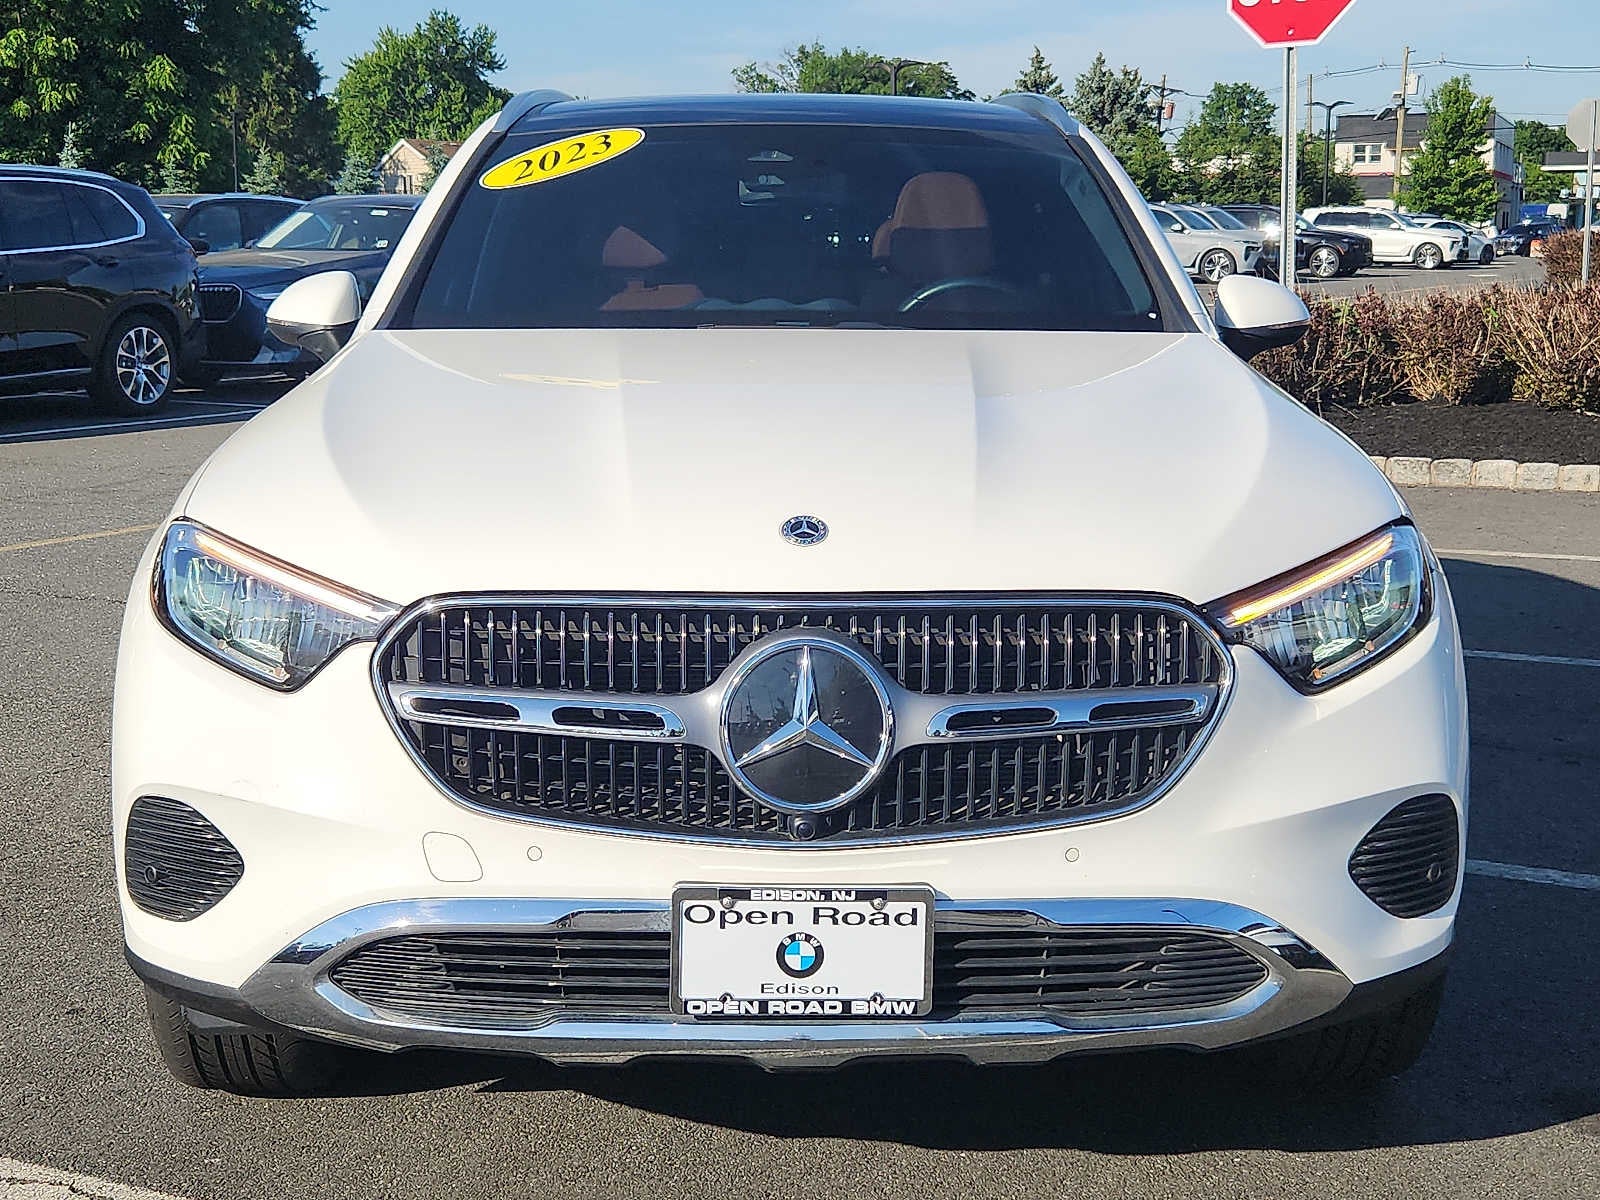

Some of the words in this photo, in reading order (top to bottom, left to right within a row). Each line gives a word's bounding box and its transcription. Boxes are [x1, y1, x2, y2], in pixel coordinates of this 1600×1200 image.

[513, 134, 612, 182] 2023
[750, 889, 826, 901] EDISON,
[832, 890, 856, 901] NJ
[684, 904, 794, 929] Open
[812, 906, 919, 926] Road
[760, 983, 839, 995] Edison
[686, 1000, 760, 1015] OPEN
[768, 1000, 843, 1015] ROAD
[851, 1000, 916, 1015] BMW
